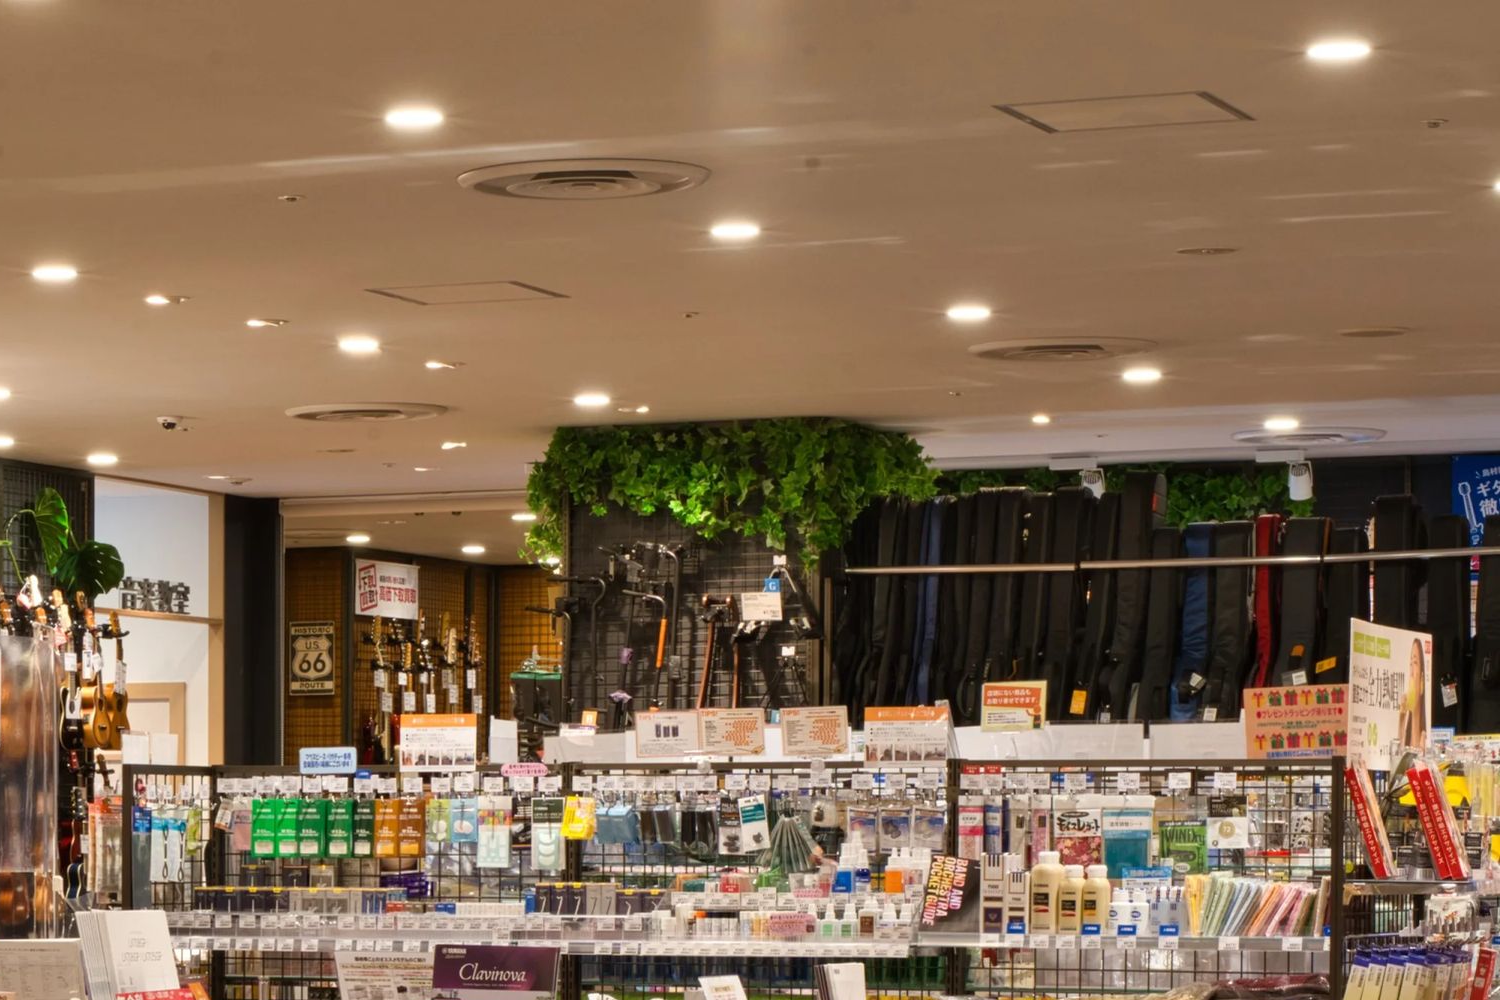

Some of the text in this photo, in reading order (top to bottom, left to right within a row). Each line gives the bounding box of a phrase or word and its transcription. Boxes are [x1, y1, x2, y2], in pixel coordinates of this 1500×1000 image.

[299, 652, 326, 673] 66
[922, 855, 945, 927] POCKET GUIDE
[935, 856, 957, 918] ORCHESTRA
[949, 858, 969, 910] BAND AND
[459, 962, 525, 982] Clavinova
